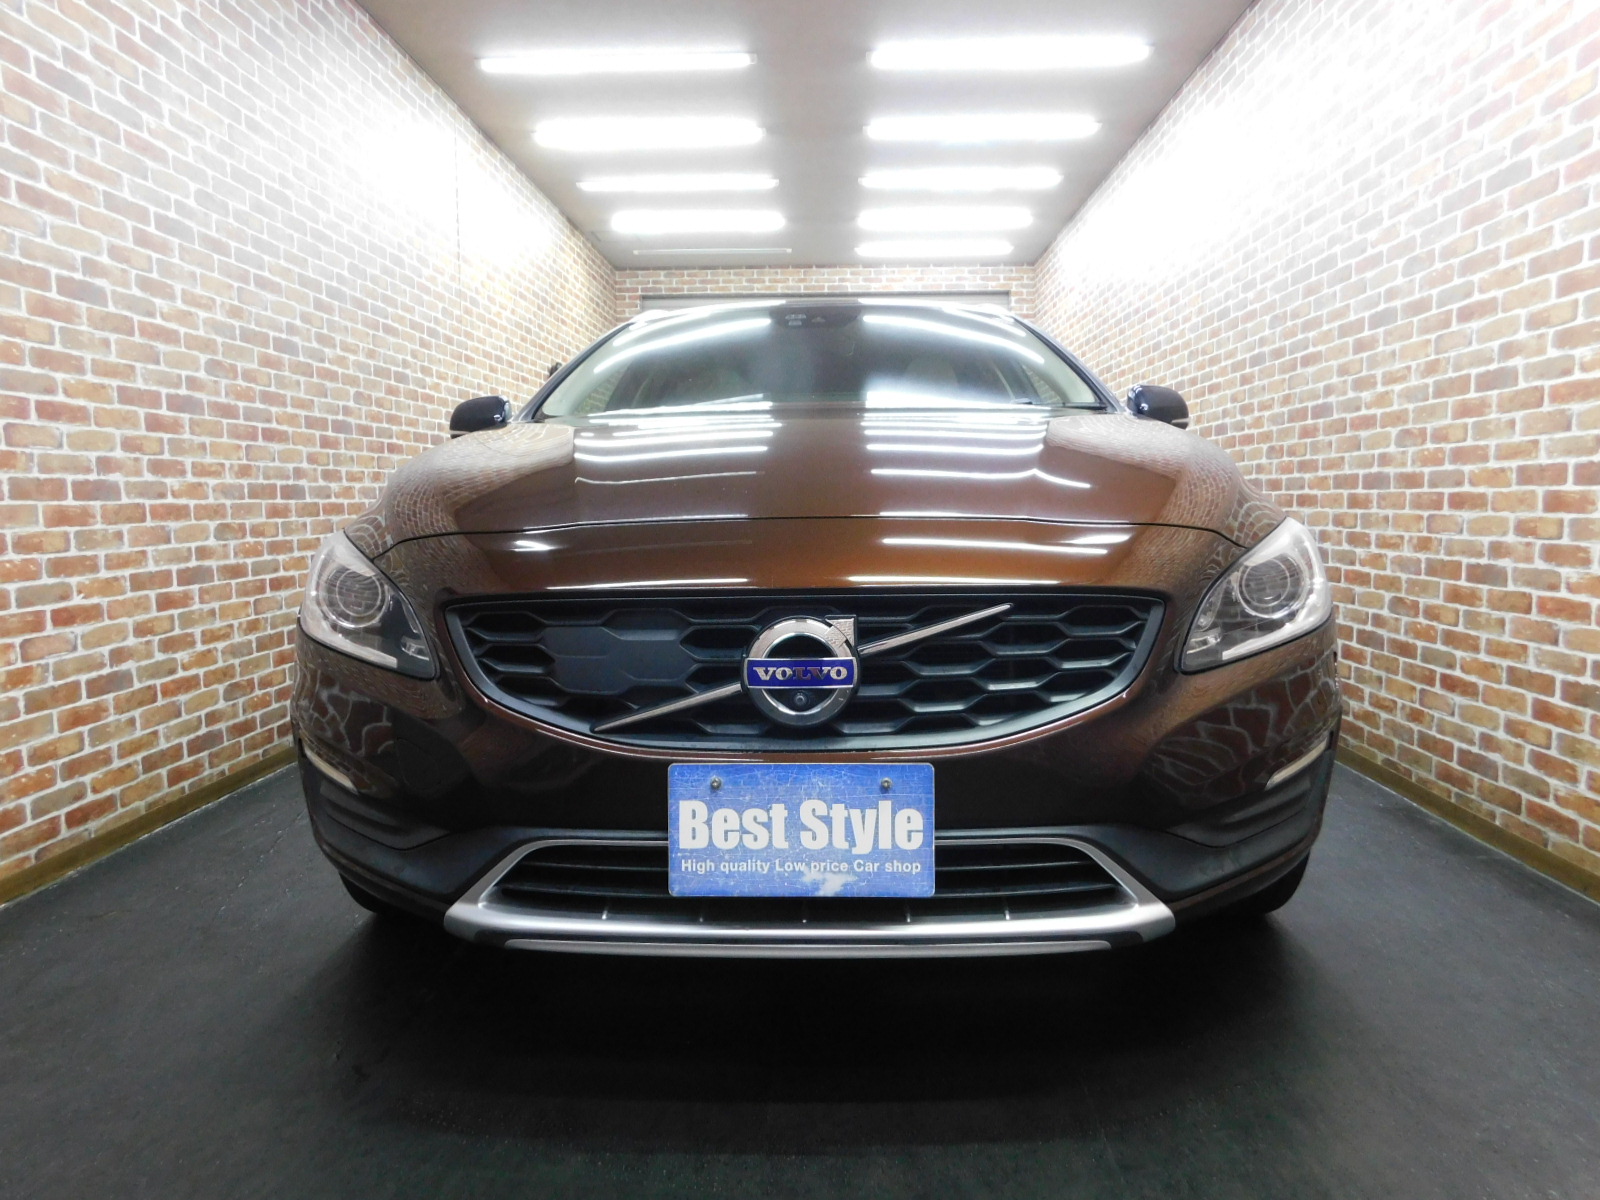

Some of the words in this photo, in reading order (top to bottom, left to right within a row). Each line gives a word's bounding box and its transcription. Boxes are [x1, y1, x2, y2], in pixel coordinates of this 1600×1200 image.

[752, 666, 848, 681] VOLVO
[679, 799, 790, 850] Best
[799, 799, 924, 855] Style
[681, 859, 715, 874] High
[720, 859, 770, 874] quality
[774, 859, 806, 872] Low
[810, 860, 849, 874] price
[853, 860, 880, 872] Car
[884, 859, 921, 875] shop
